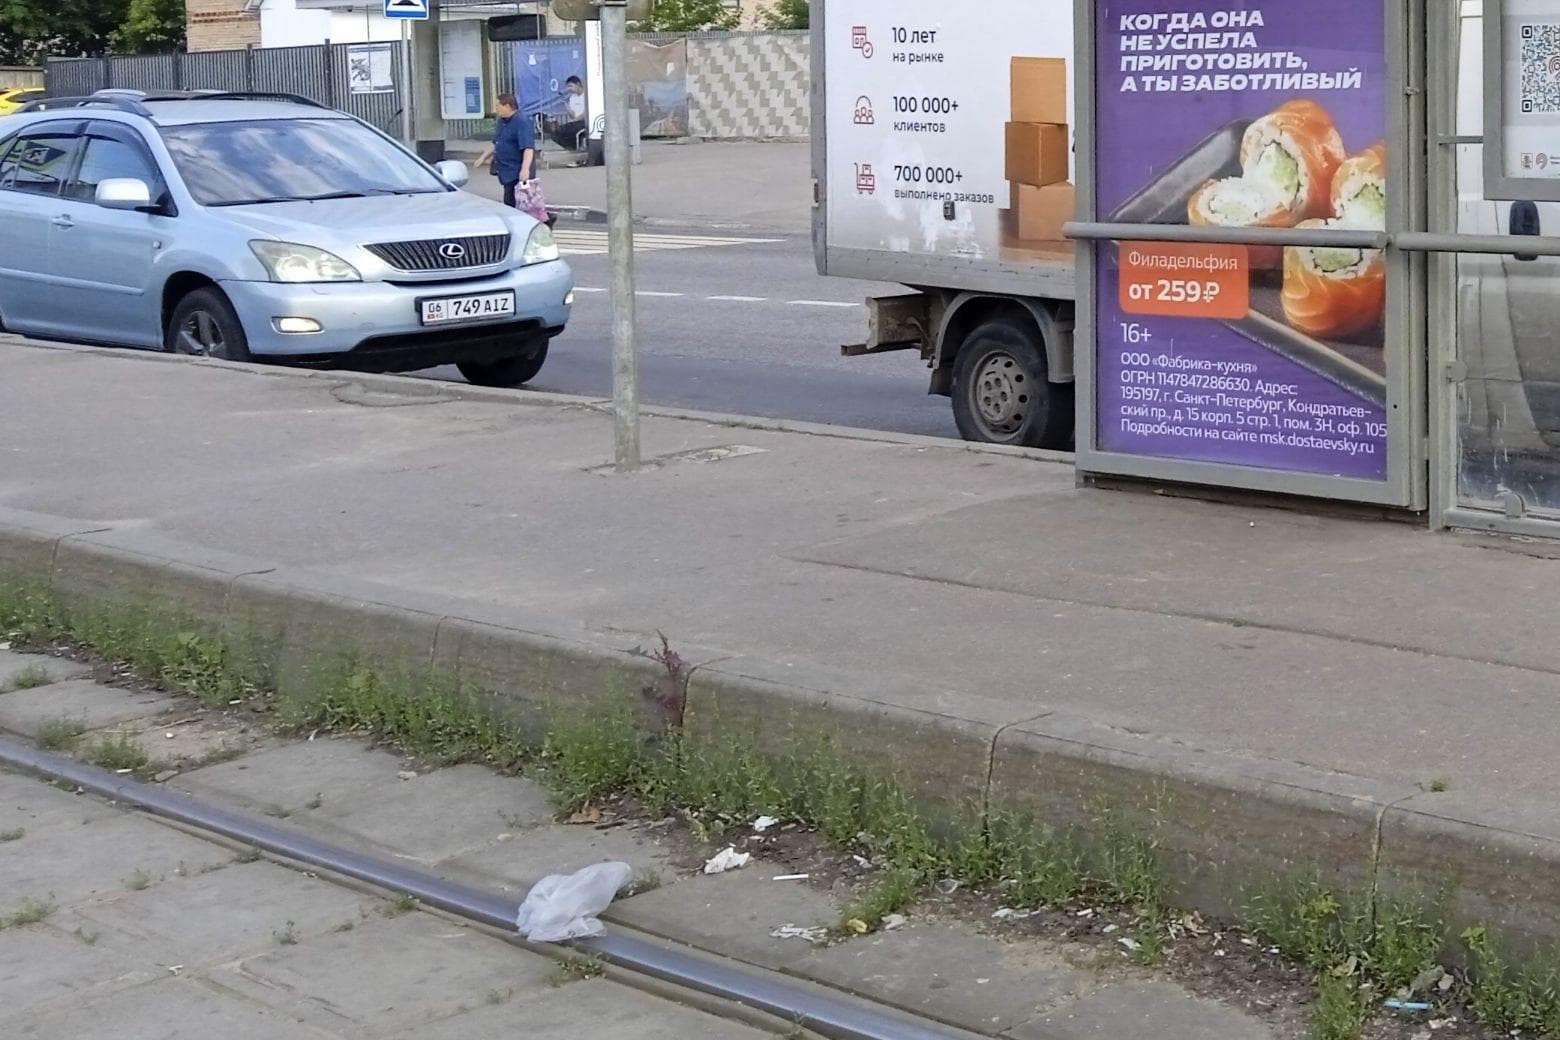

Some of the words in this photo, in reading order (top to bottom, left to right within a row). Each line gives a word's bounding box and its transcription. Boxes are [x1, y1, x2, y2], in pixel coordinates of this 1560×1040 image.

[1120, 13, 1207, 32] КОГДА
[1211, 10, 1265, 28] ОНА
[892, 27, 907, 44] 10
[910, 30, 936, 44] лет
[1120, 34, 1153, 51] НЕ
[1156, 32, 1257, 50] УСПЕЛА
[892, 52, 906, 62] на
[908, 51, 944, 65] рынке
[1120, 52, 1308, 72] ПРИГОТОВИТЬ,
[1120, 76, 1137, 92] А
[1141, 76, 1177, 92] ТЫ
[1181, 68, 1362, 91] ЗАБОТЛИВЫЙ
[893, 96, 917, 113] 100
[921, 97, 959, 114] 000+
[893, 121, 946, 133] клиентов
[894, 165, 921, 182] 700
[925, 167, 963, 184] 000+
[894, 190, 952, 202] выполнено
[954, 193, 994, 204] заказов
[1129, 251, 1238, 273] Филадельфия
[1129, 284, 1153, 300] от
[453, 299, 480, 316] 749
[1120, 323, 1152, 343] 16+
[1121, 352, 1150, 366] ООО
[1121, 370, 1155, 385] ОГРН
[1120, 386, 1161, 403] 195197,
[1164, 392, 1172, 402] г.
[1175, 390, 1286, 413] Санкт-Петербург,
[1288, 399, 1372, 417] Кондратьев-
[1121, 404, 1148, 416] ский
[1173, 409, 1184, 421] д.
[1186, 407, 1199, 420] 15
[1201, 411, 1234, 426] корп.
[1236, 411, 1245, 424] 5
[1247, 415, 1271, 430] стр.
[1284, 418, 1312, 431] пом.
[1337, 421, 1362, 438] оф.
[1365, 422, 1387, 437] 105
[1121, 419, 1202, 437] Подробности
[1204, 428, 1219, 439] на
[1221, 428, 1257, 442] сайте
[1260, 431, 1375, 455] msk.dostaevsky.ru
